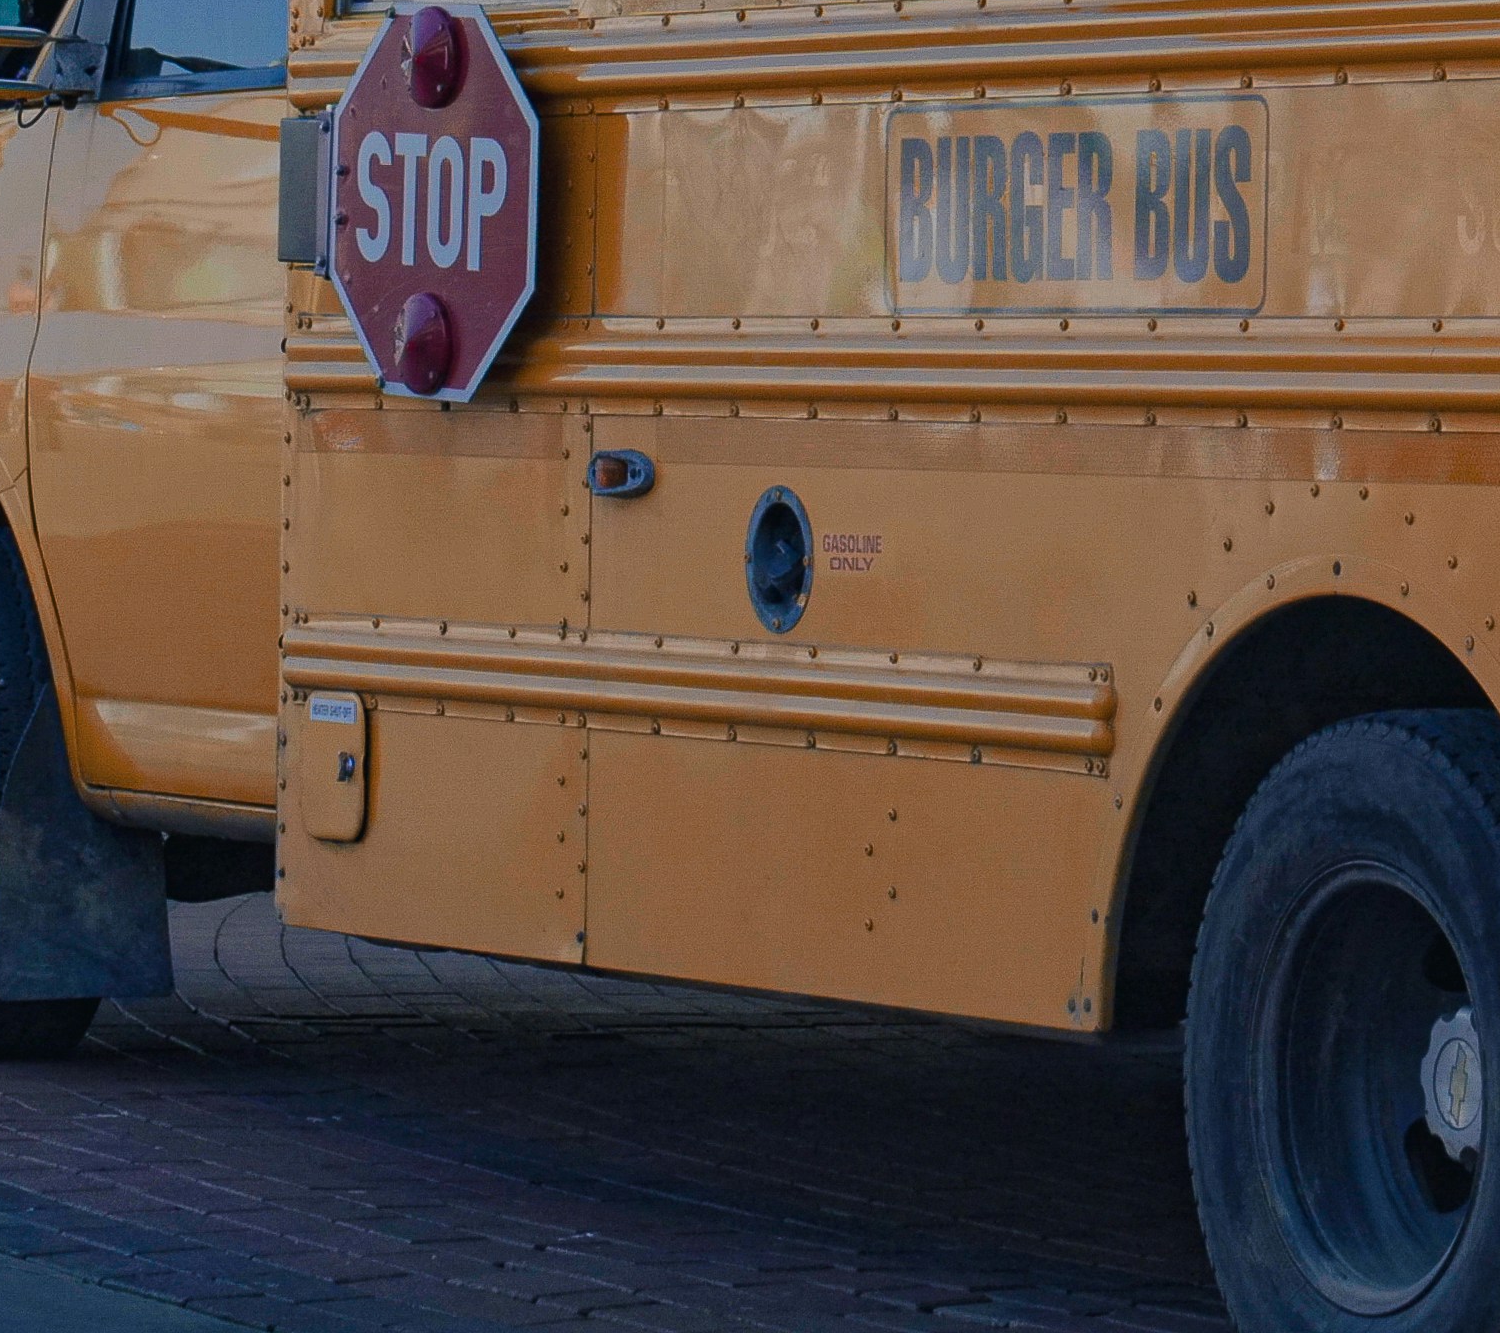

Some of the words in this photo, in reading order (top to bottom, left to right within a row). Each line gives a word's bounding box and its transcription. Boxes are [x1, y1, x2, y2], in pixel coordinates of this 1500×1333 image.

[354, 130, 509, 273] STOP
[898, 129, 1115, 284] BURGER
[1132, 123, 1253, 284] BUS
[822, 533, 883, 555] GASOLINE
[829, 555, 875, 572] ONLY
